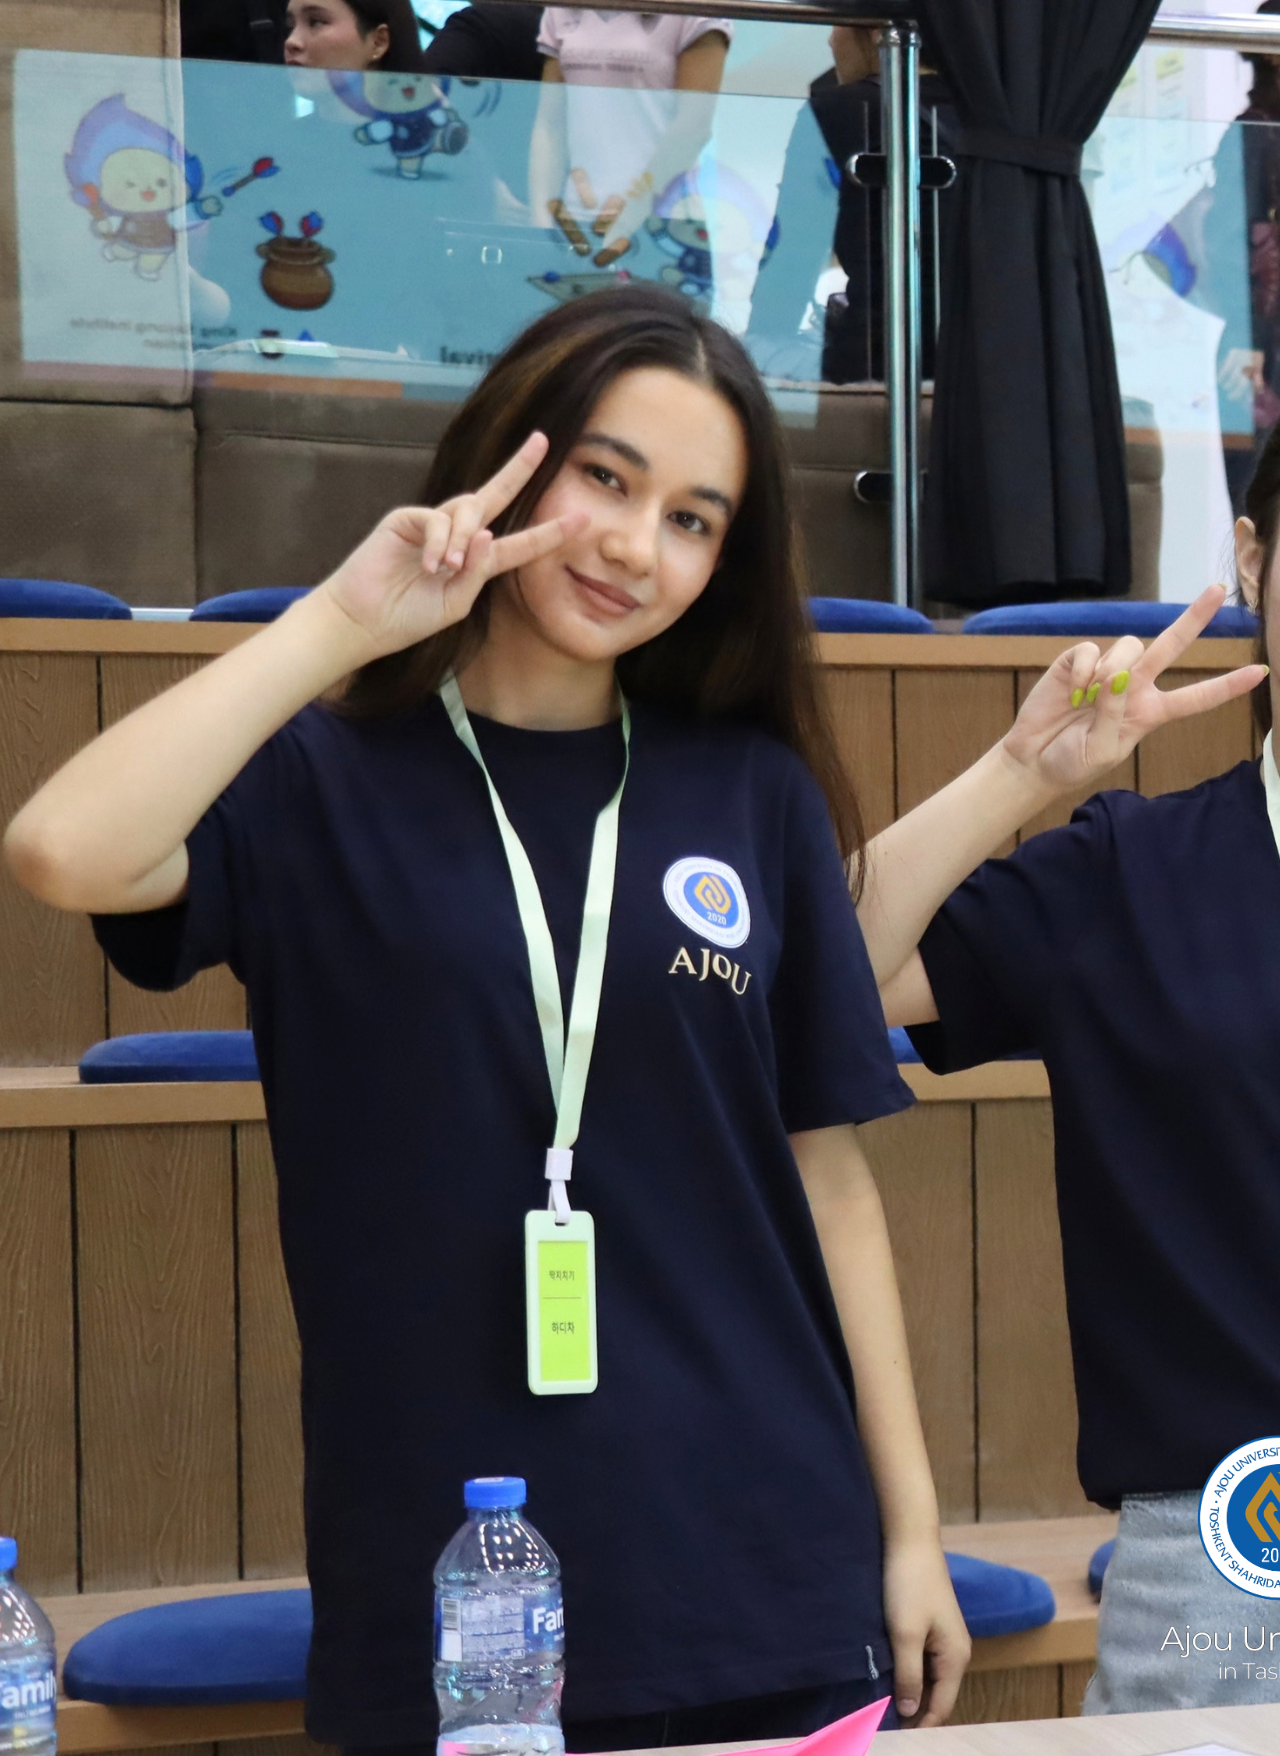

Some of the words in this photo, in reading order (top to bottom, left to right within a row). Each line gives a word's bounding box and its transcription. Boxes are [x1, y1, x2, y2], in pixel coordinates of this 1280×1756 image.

[707, 911, 727, 926] 2020
[668, 946, 752, 996] AJOU
[551, 1321, 575, 1335] 하디차
